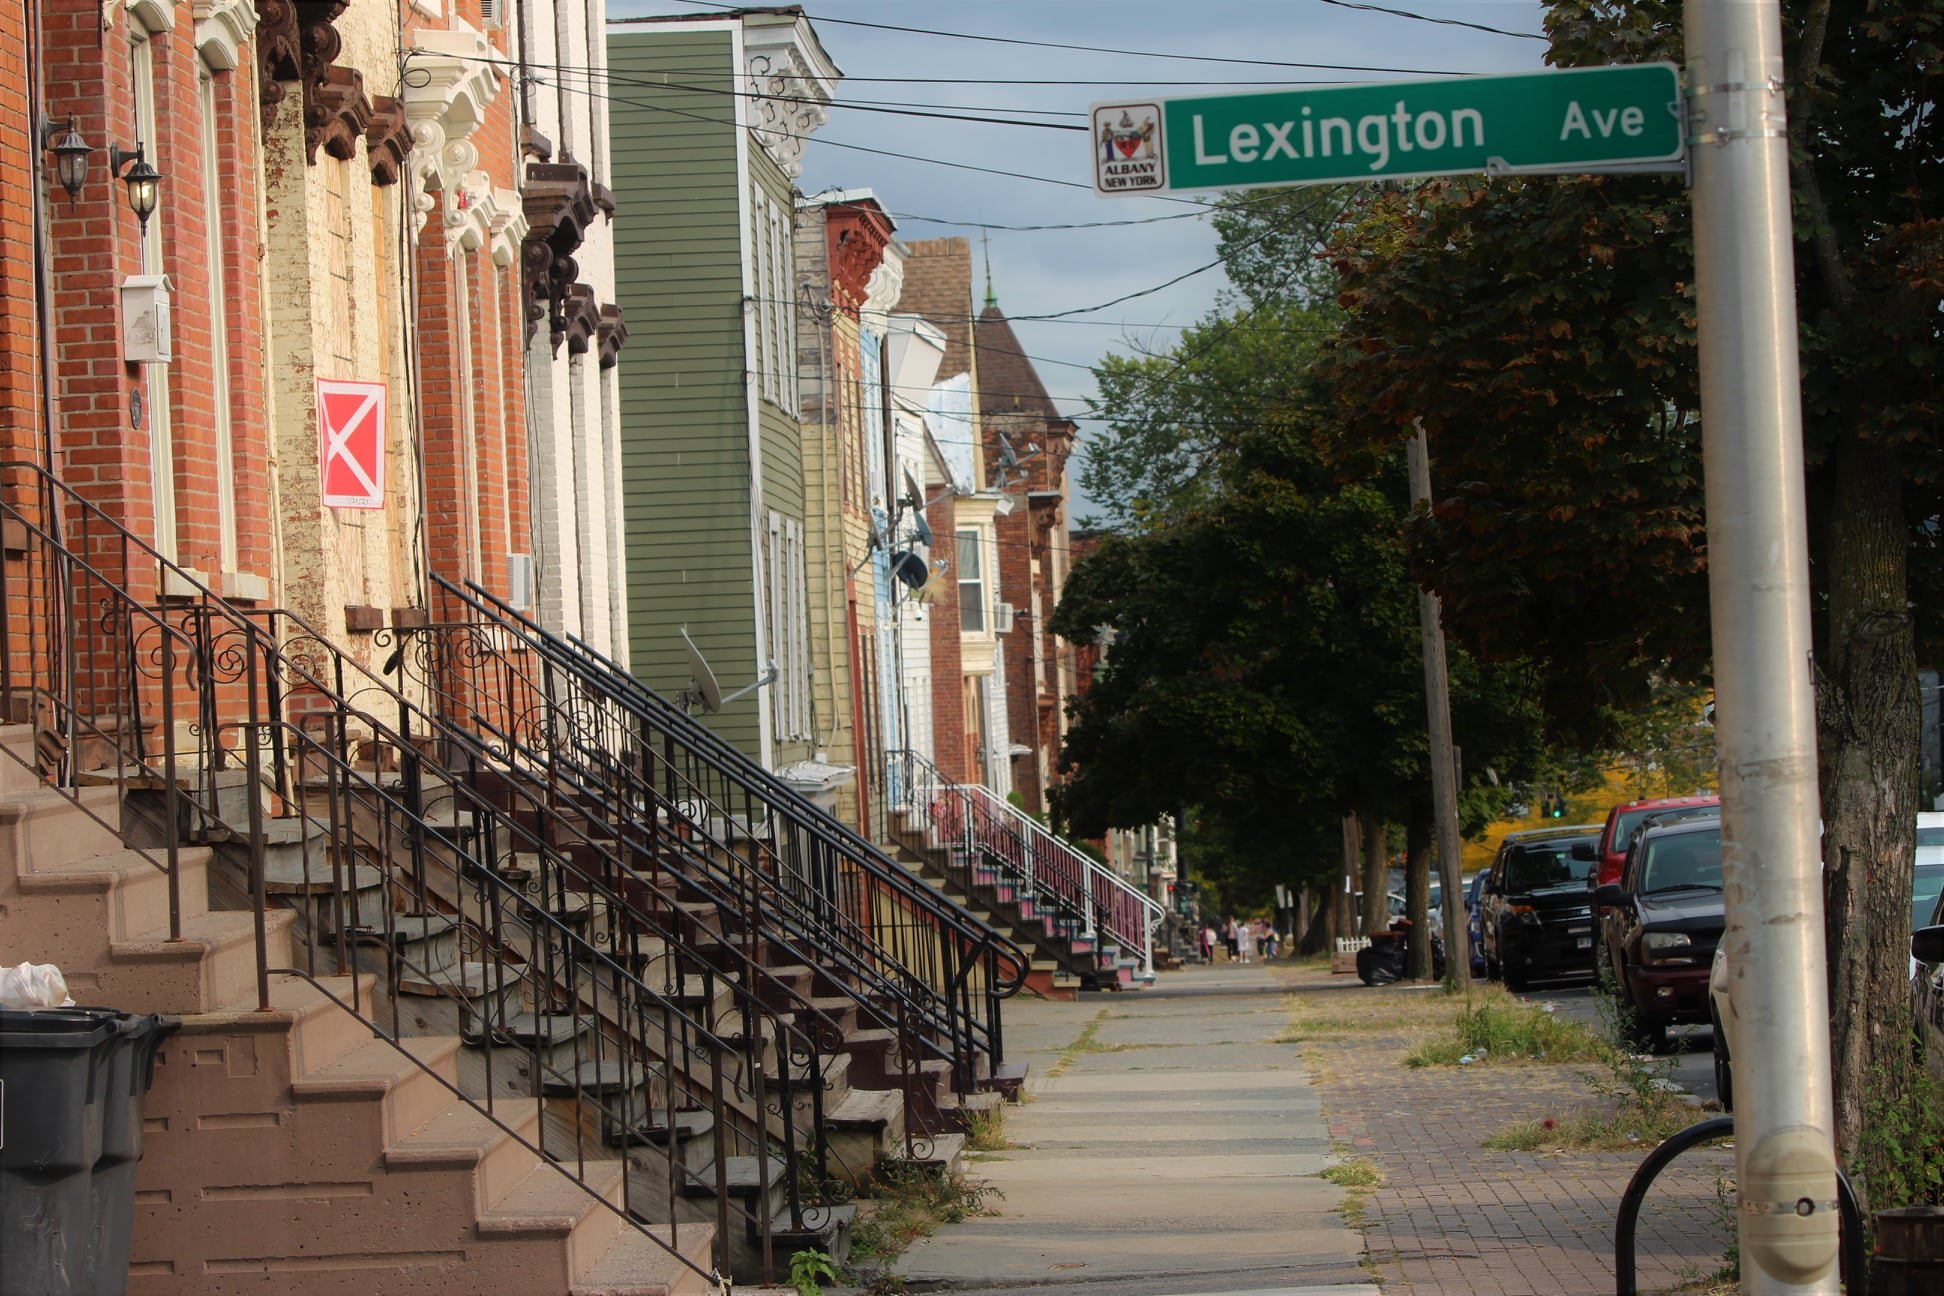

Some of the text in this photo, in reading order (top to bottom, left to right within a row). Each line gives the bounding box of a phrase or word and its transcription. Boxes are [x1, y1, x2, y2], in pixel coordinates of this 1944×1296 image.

[1192, 99, 1645, 172] Lexington Ave
[1104, 162, 1156, 176] ALBANY
[1104, 174, 1158, 188] NEW YORK
